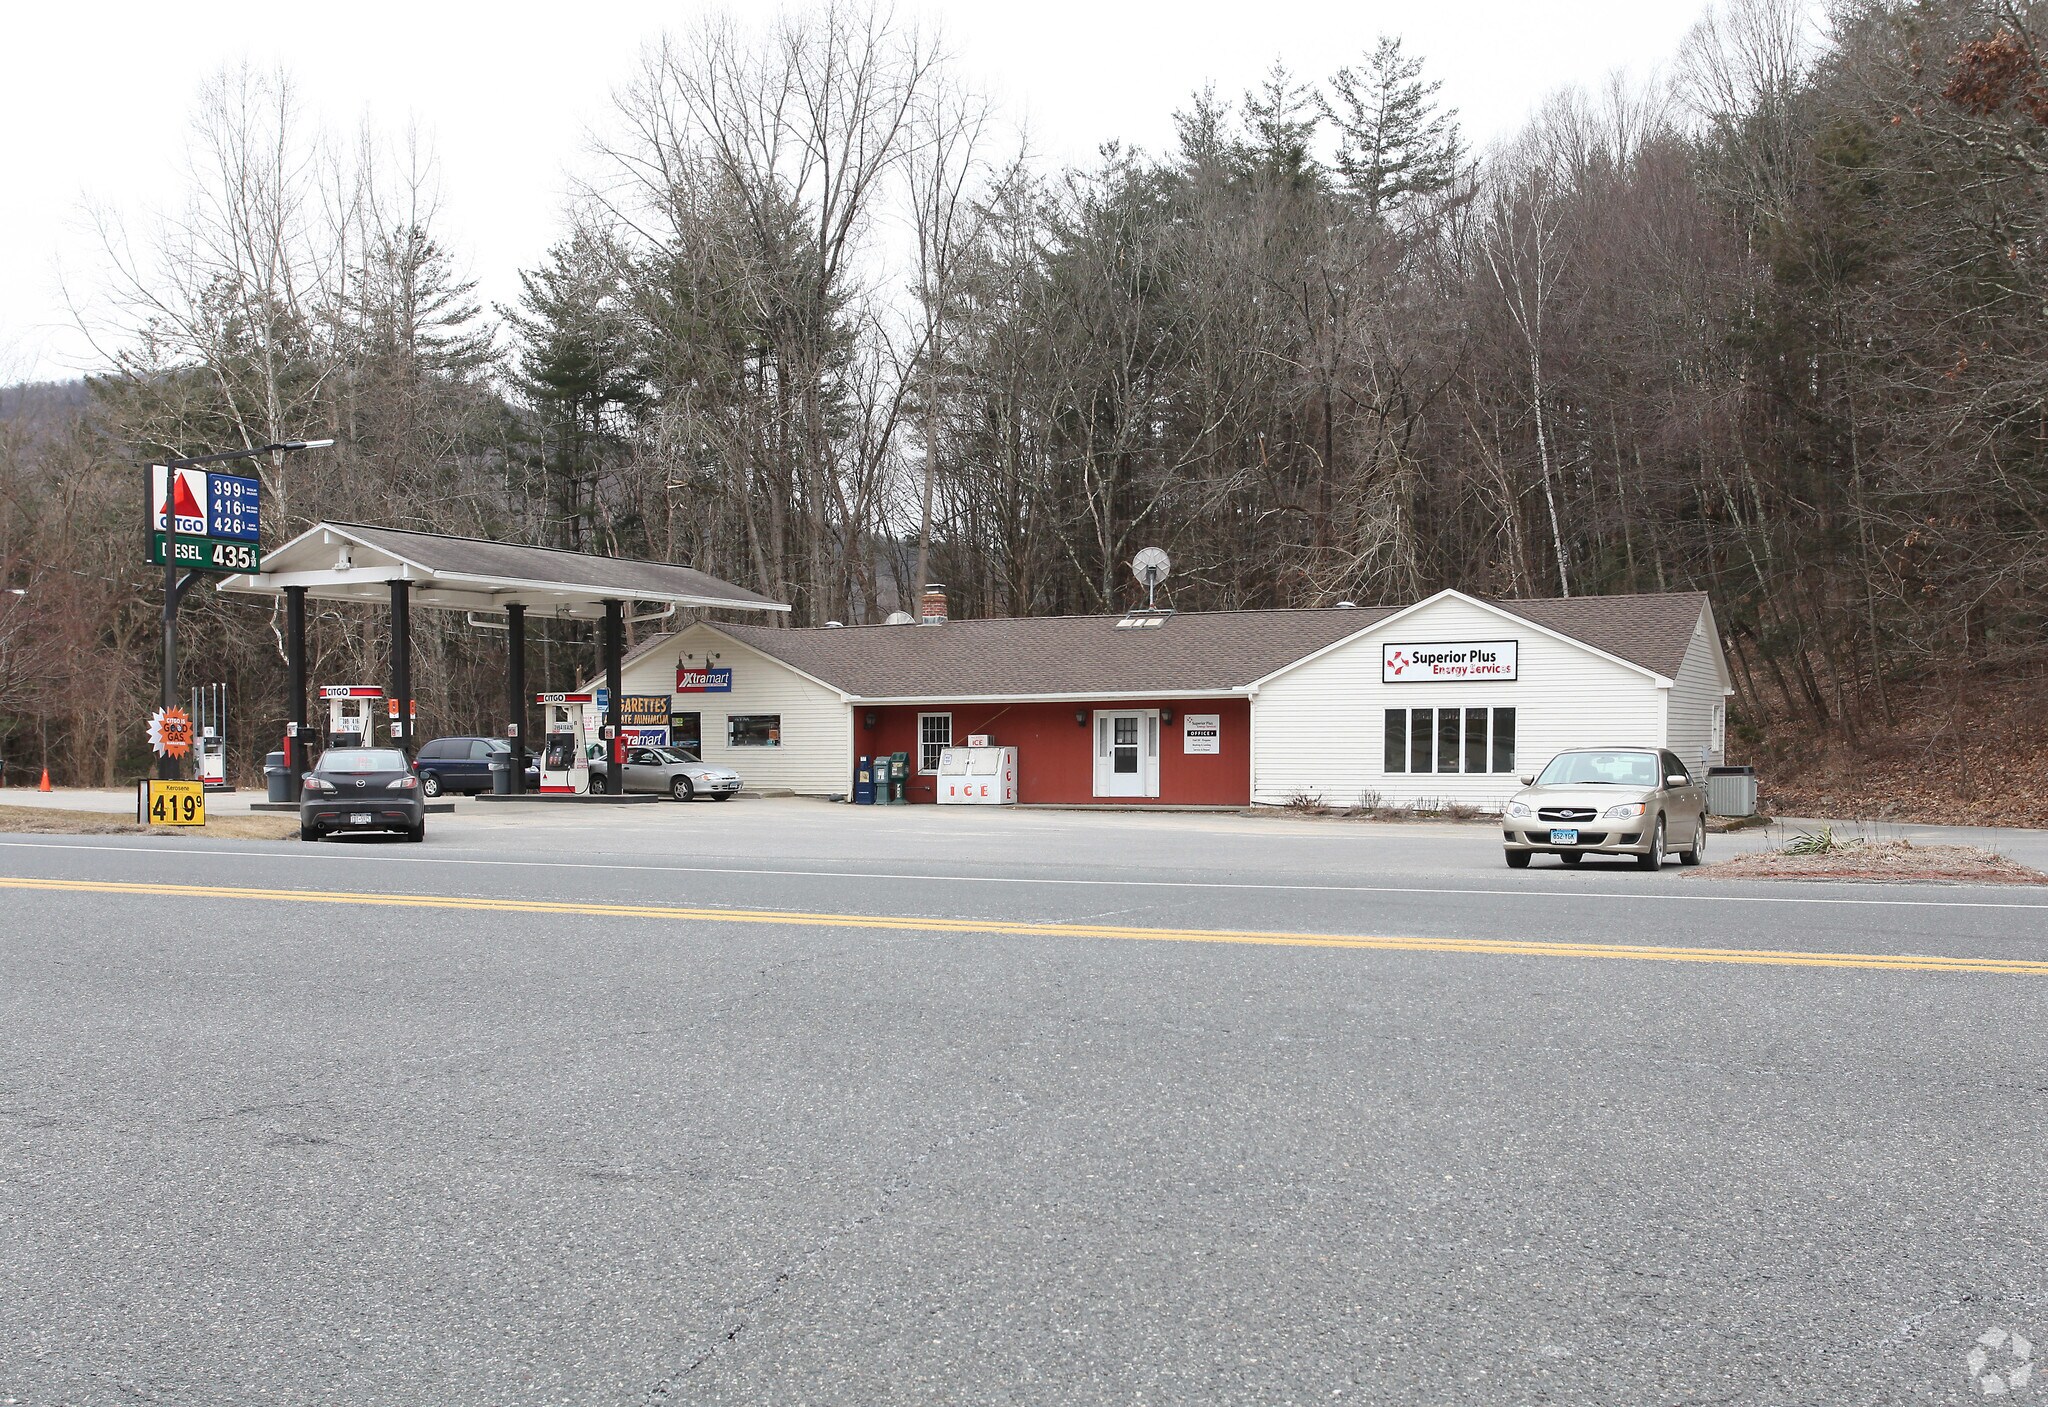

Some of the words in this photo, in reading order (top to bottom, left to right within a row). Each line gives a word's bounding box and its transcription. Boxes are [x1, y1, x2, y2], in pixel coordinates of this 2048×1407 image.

[214, 480, 241, 497] 399
[214, 499, 241, 516] 416
[160, 516, 204, 532] CTGO
[214, 517, 241, 534] 426
[161, 542, 202, 560] DESEL
[212, 545, 250, 568] 435
[1412, 650, 1467, 667] Superior
[1470, 649, 1496, 663] Plus
[1433, 664, 1468, 677] Energy
[1470, 663, 1511, 674] Services
[678, 672, 730, 688] Xtramart
[327, 687, 349, 696] CITGO
[543, 693, 564, 702] CITGO
[163, 723, 188, 733] GOOD
[950, 784, 989, 797] ICE
